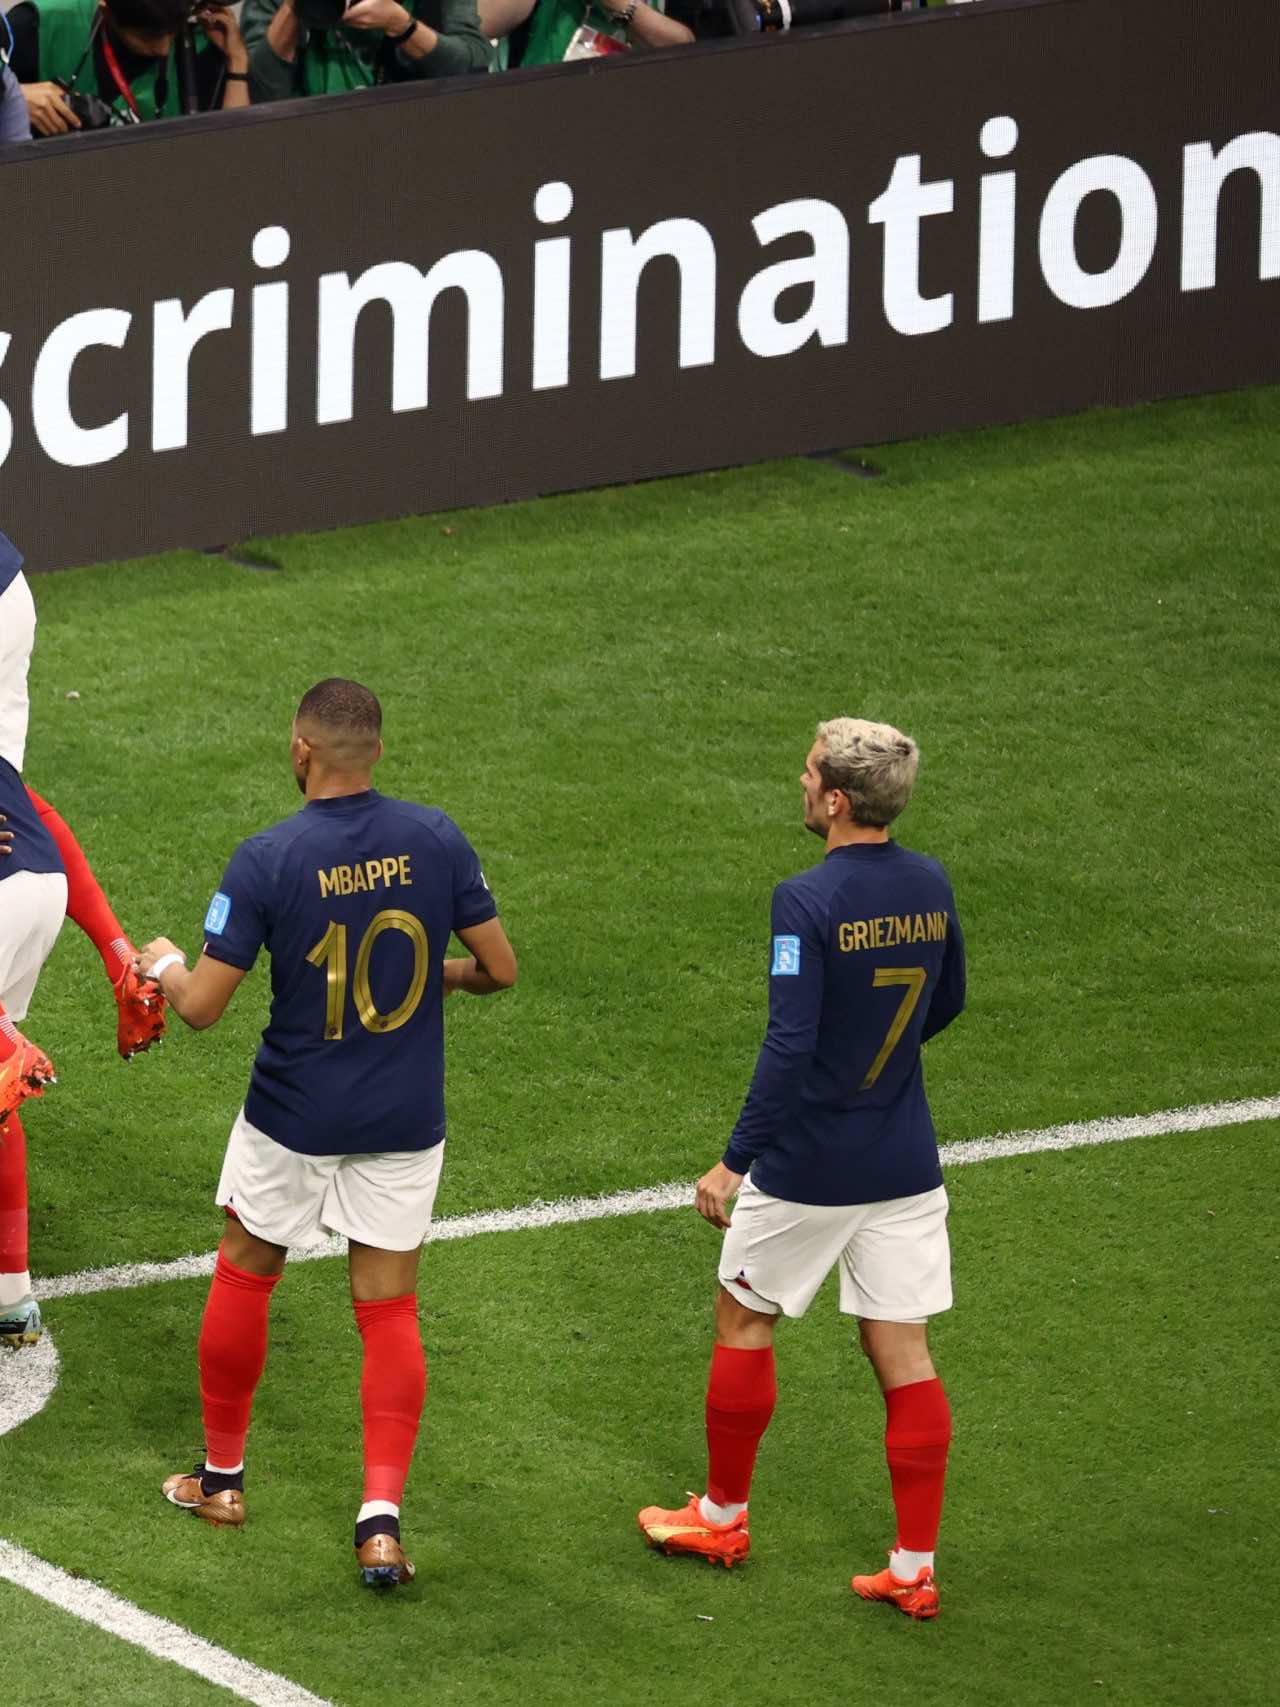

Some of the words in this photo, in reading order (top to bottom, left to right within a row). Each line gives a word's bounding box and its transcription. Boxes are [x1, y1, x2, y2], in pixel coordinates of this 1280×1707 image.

[317, 855, 413, 898] MBAPPE
[838, 911, 949, 952] GRIEZMANN
[304, 909, 429, 1041] 10
[857, 966, 927, 1091] 7
